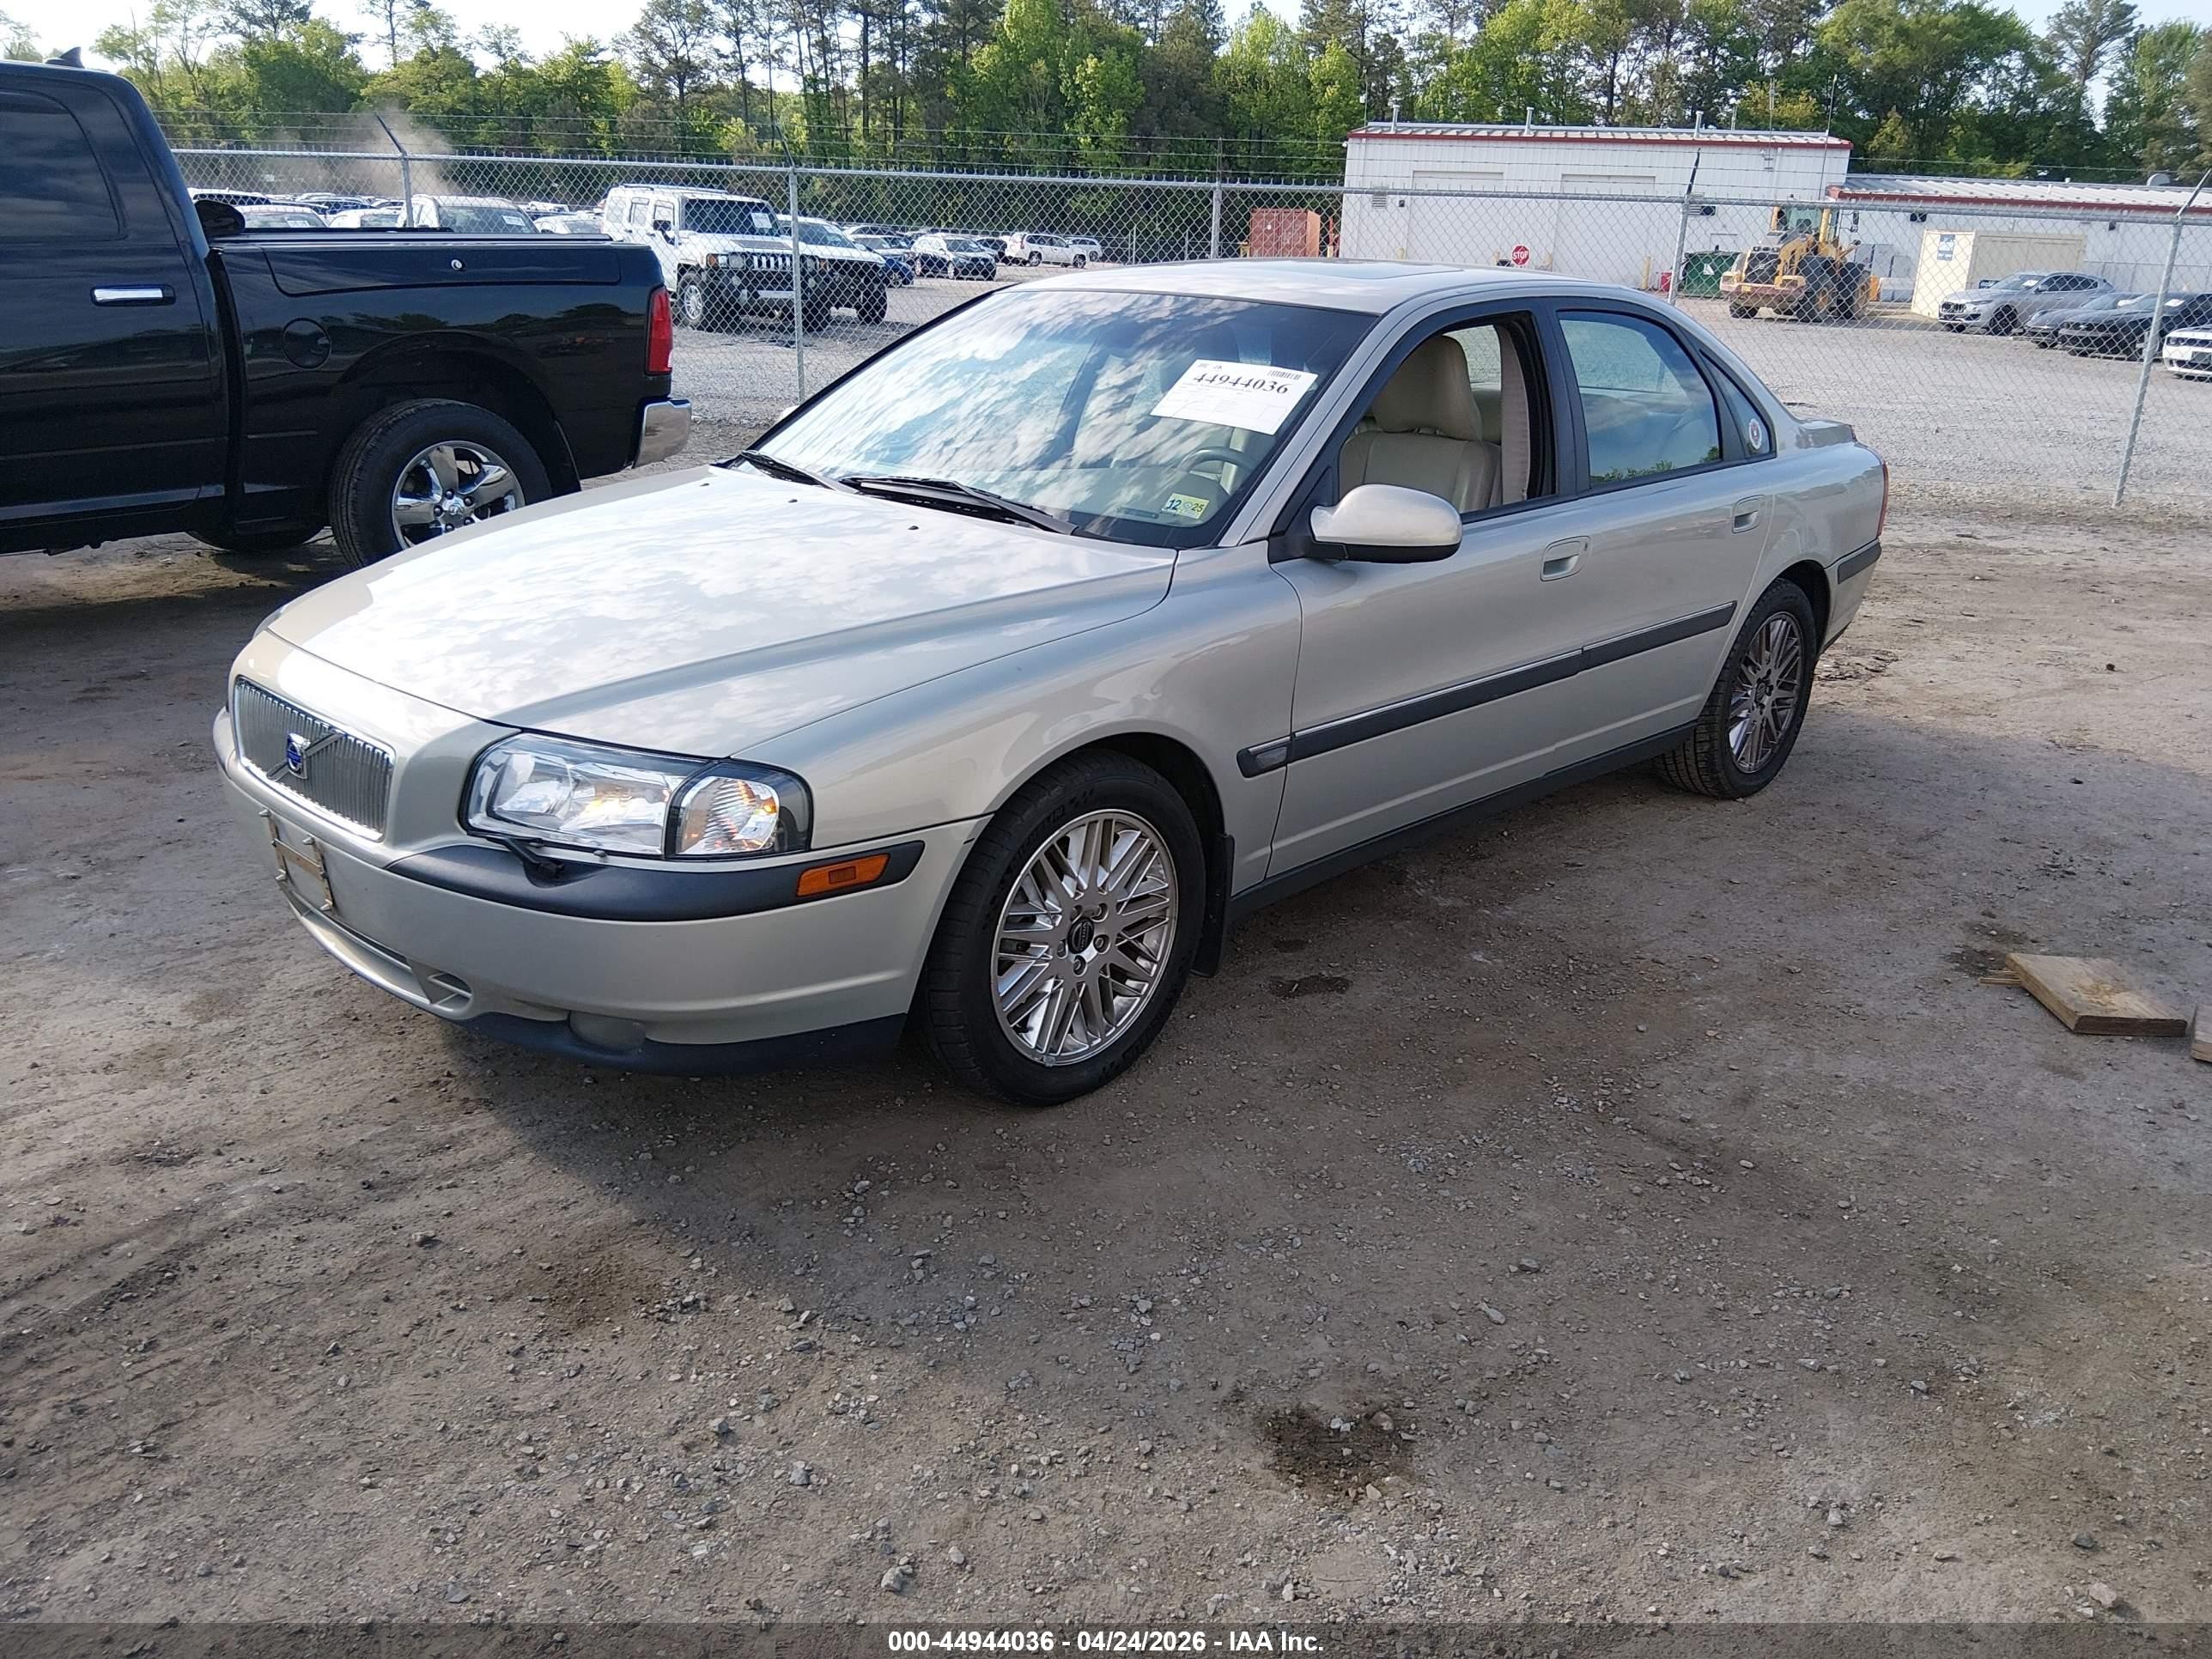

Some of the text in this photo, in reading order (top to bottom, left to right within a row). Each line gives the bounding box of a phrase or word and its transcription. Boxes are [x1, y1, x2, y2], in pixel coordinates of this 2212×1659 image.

[1513, 251, 1528, 259] STOP
[1194, 373, 1291, 394] 44944036
[1167, 499, 1205, 513] 12 25
